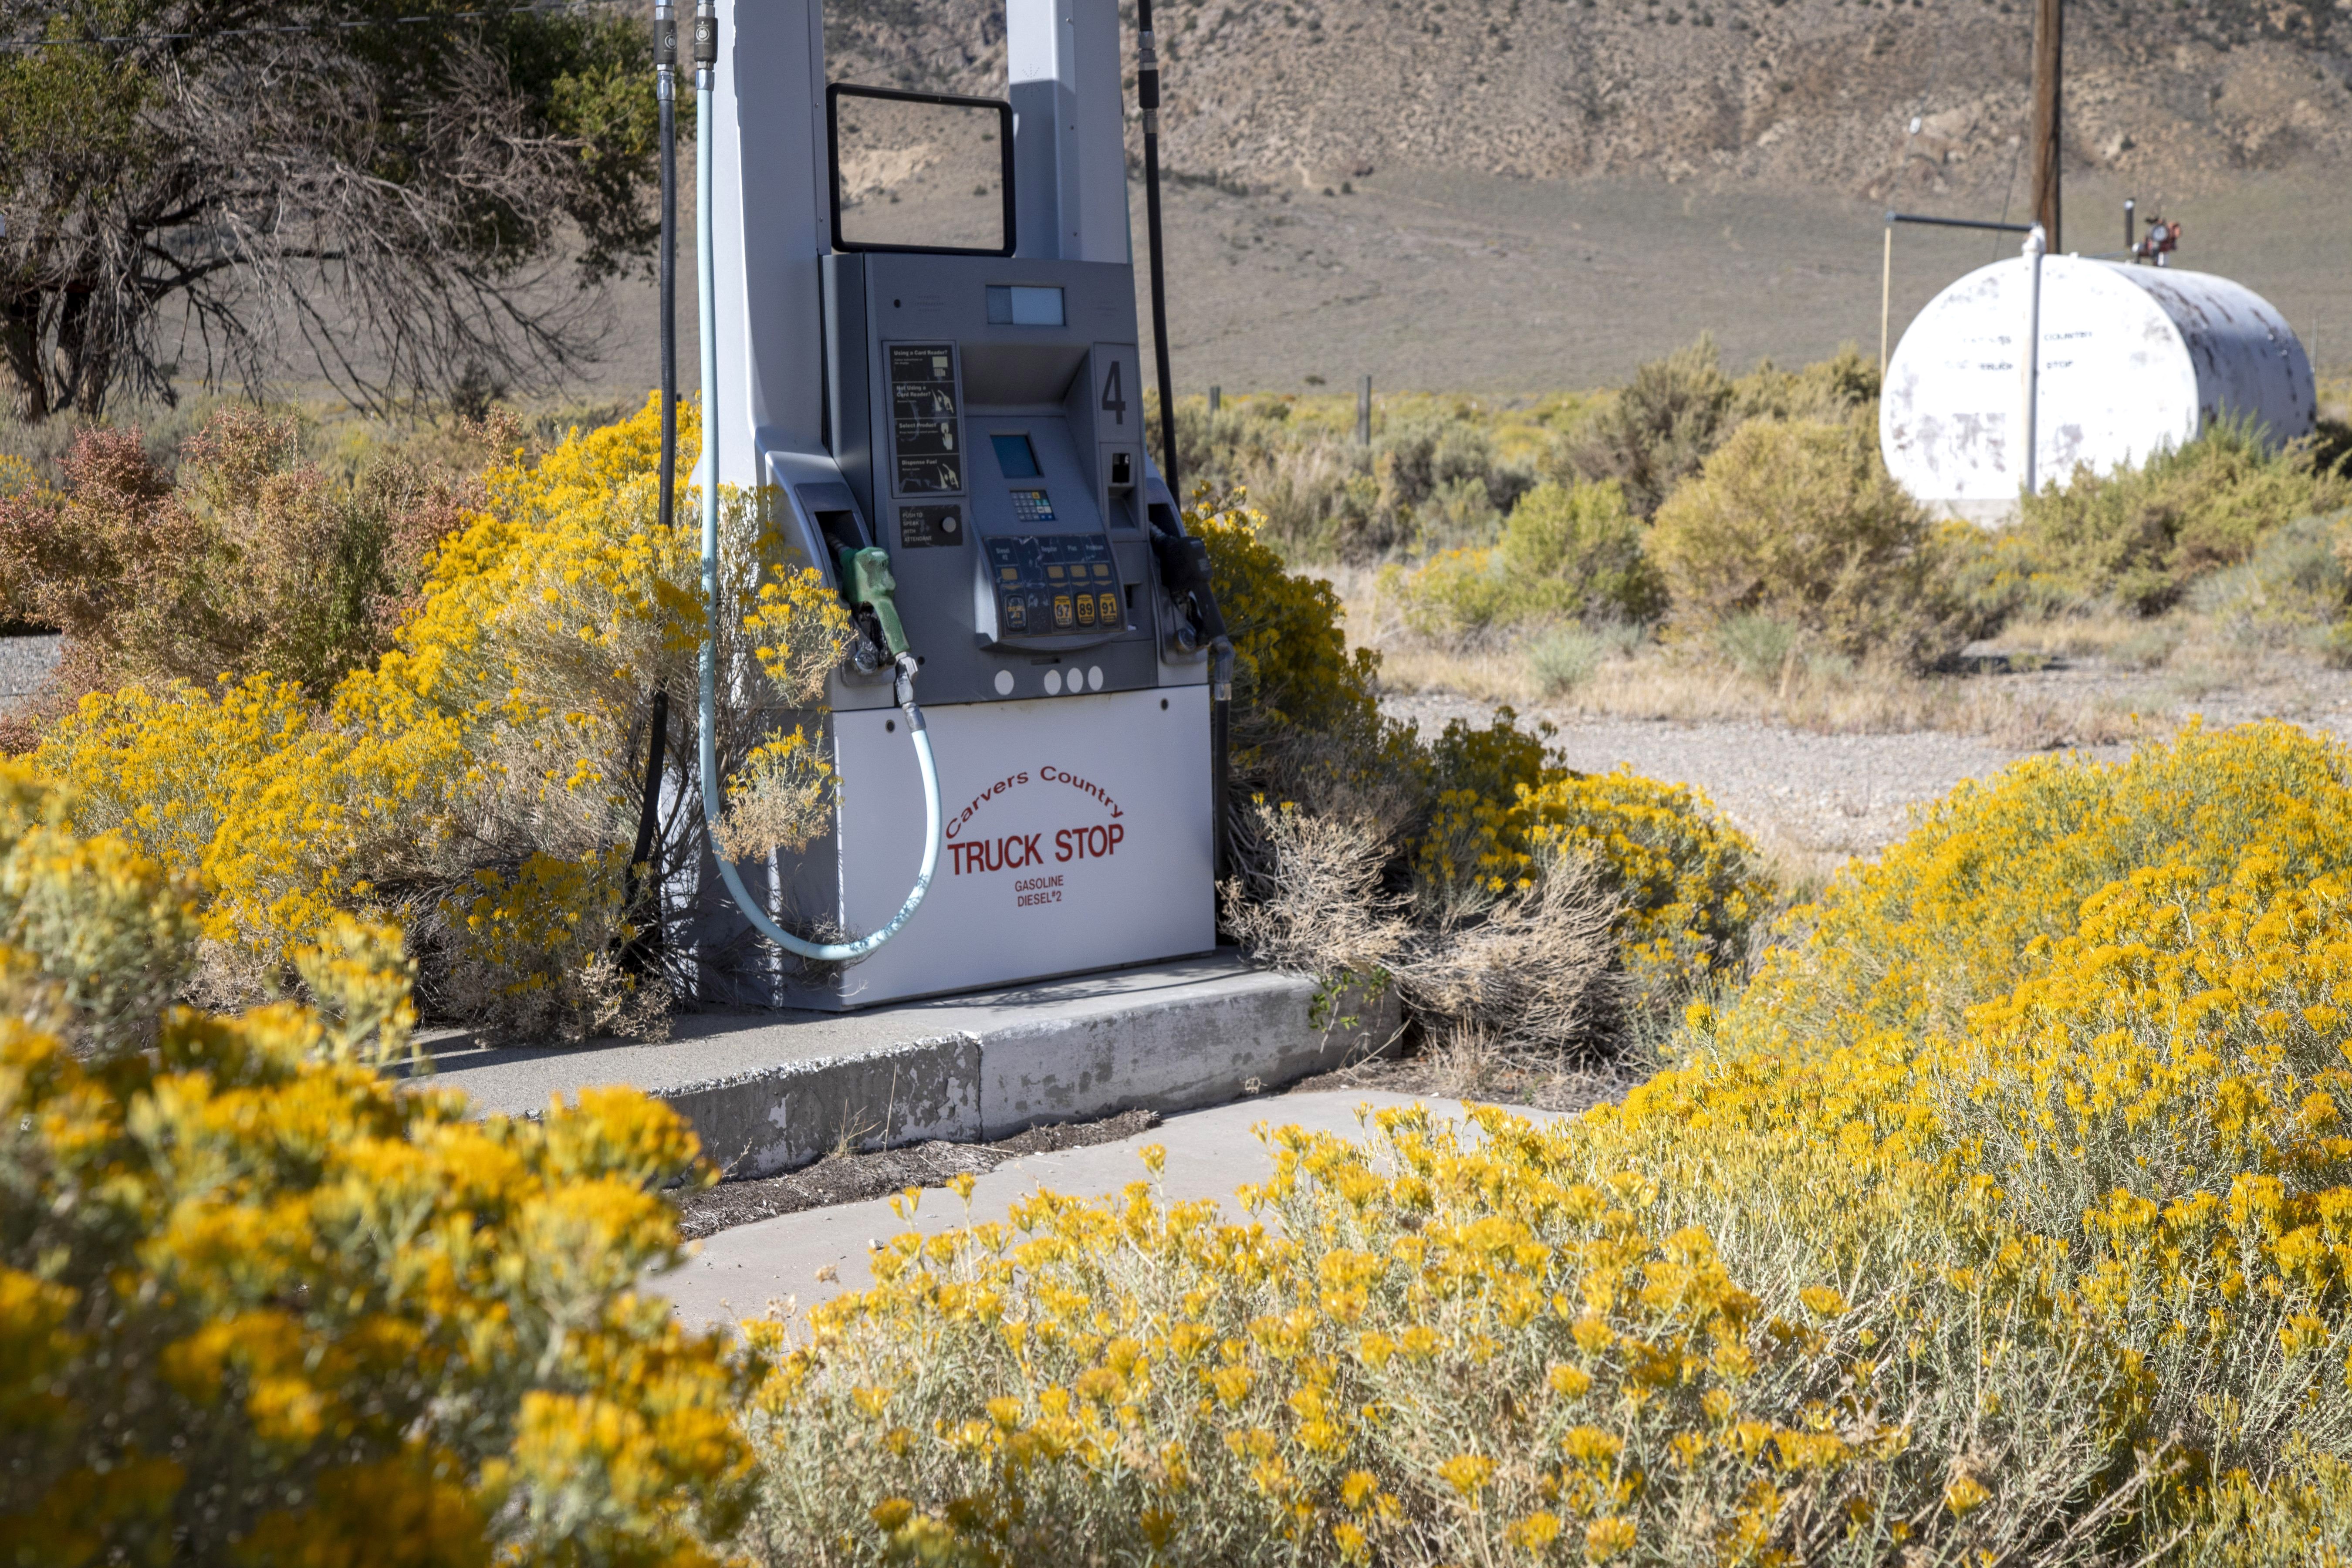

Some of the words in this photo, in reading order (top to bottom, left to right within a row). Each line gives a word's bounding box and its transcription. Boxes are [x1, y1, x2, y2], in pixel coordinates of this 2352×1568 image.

[1102, 361, 1125, 425] 4
[1057, 604, 1070, 617] 87
[1079, 603, 1092, 615] 89
[1102, 602, 1116, 614] 91
[946, 771, 1029, 839] Carvers
[1040, 766, 1124, 819] Country
[947, 832, 1044, 875] TRUCK
[1054, 823, 1124, 863] STOP
[1014, 875, 1064, 892] GASOLINE
